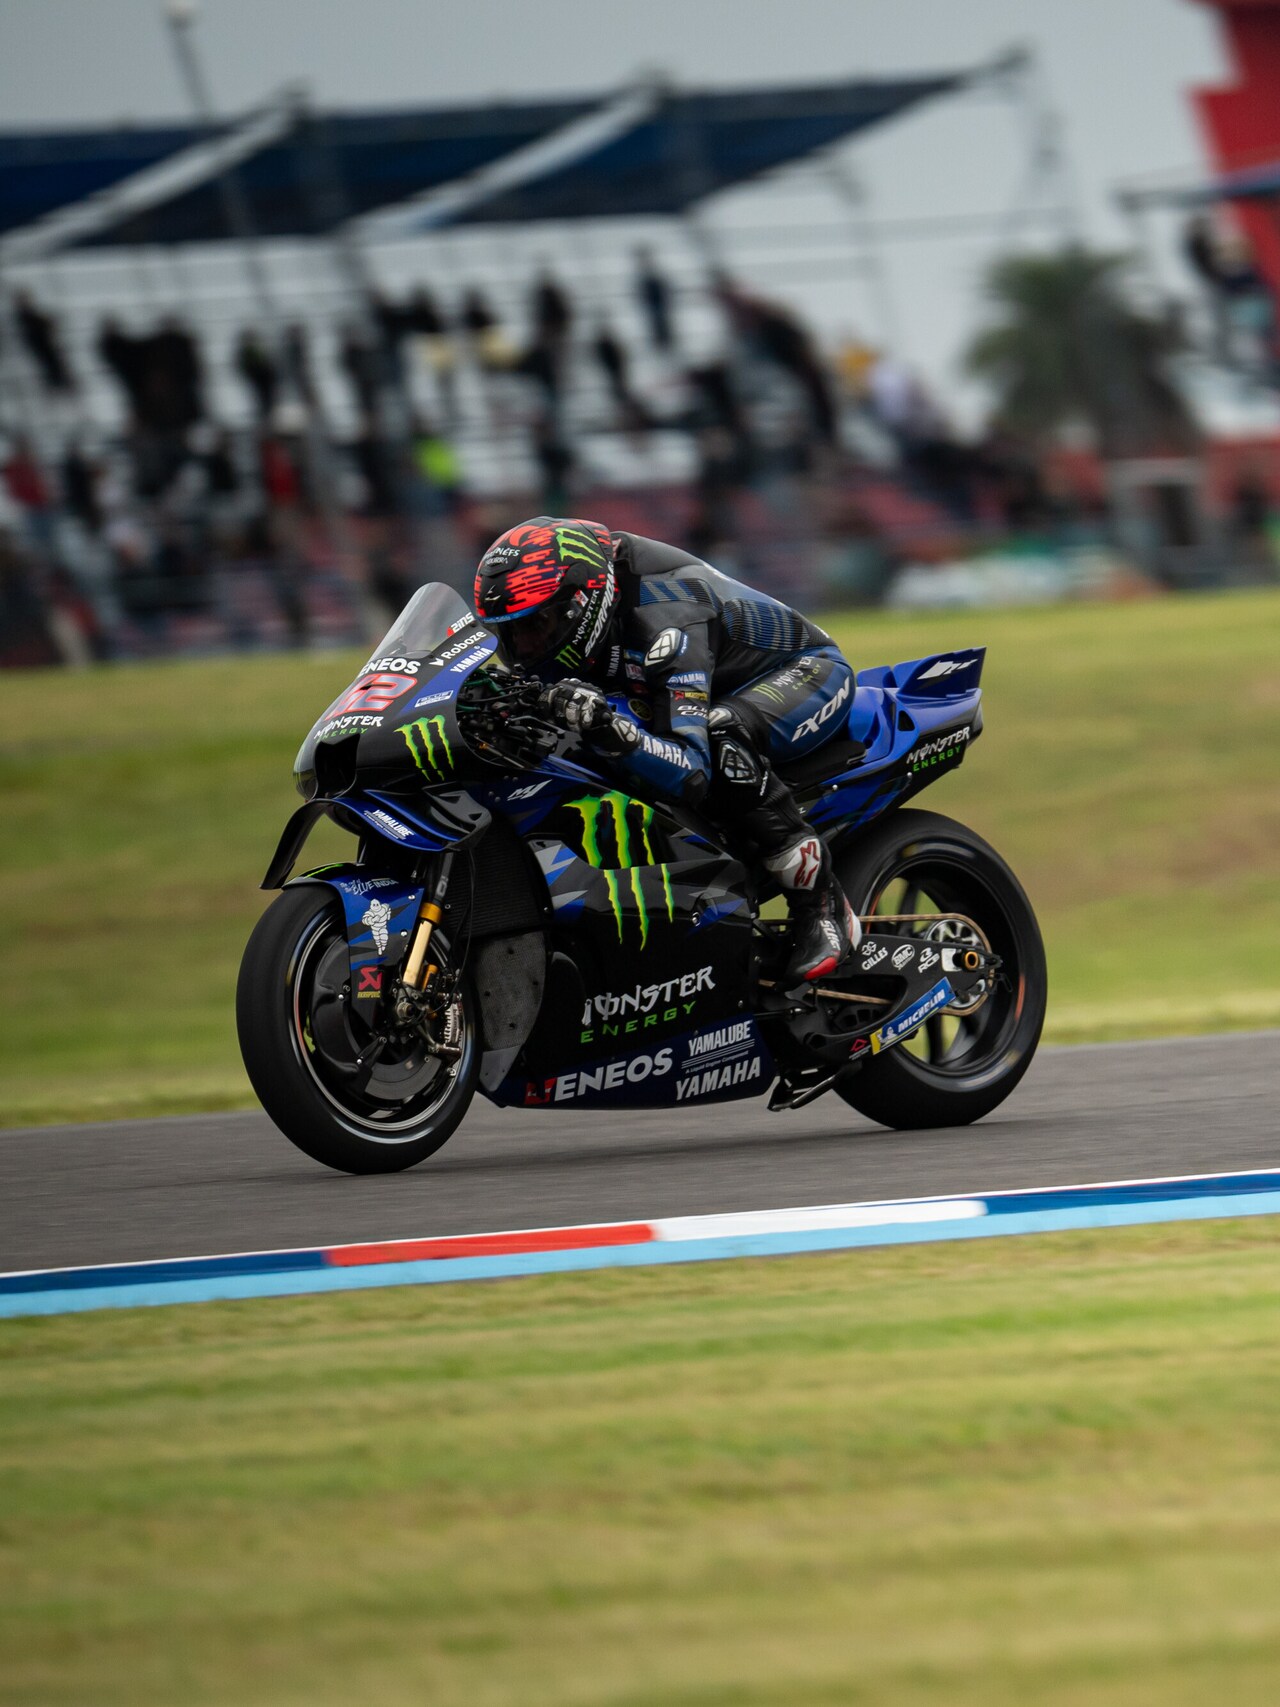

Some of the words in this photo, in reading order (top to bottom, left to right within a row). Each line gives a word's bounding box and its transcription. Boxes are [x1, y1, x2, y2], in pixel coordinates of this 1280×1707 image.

[572, 589, 600, 646] MONSTER
[441, 631, 487, 660] Roboze
[450, 647, 494, 673] YAMAHA
[359, 657, 421, 677] ENEOS
[606, 645, 621, 677] YAMAHA
[314, 715, 384, 739] MONSTER
[905, 726, 971, 765] MONSTER
[913, 745, 962, 773] ENERGY
[372, 809, 415, 837] YAMALUBE
[861, 946, 889, 971] GILLES
[893, 947, 914, 966] BMC
[917, 952, 941, 974] RCB
[580, 1001, 696, 1043] ENERGY
[898, 988, 946, 1033] MICHELIN
[688, 1019, 754, 1057] YAMALUBE
[554, 1047, 674, 1101] ENEOS
[676, 1056, 761, 1101] YAMAHA
